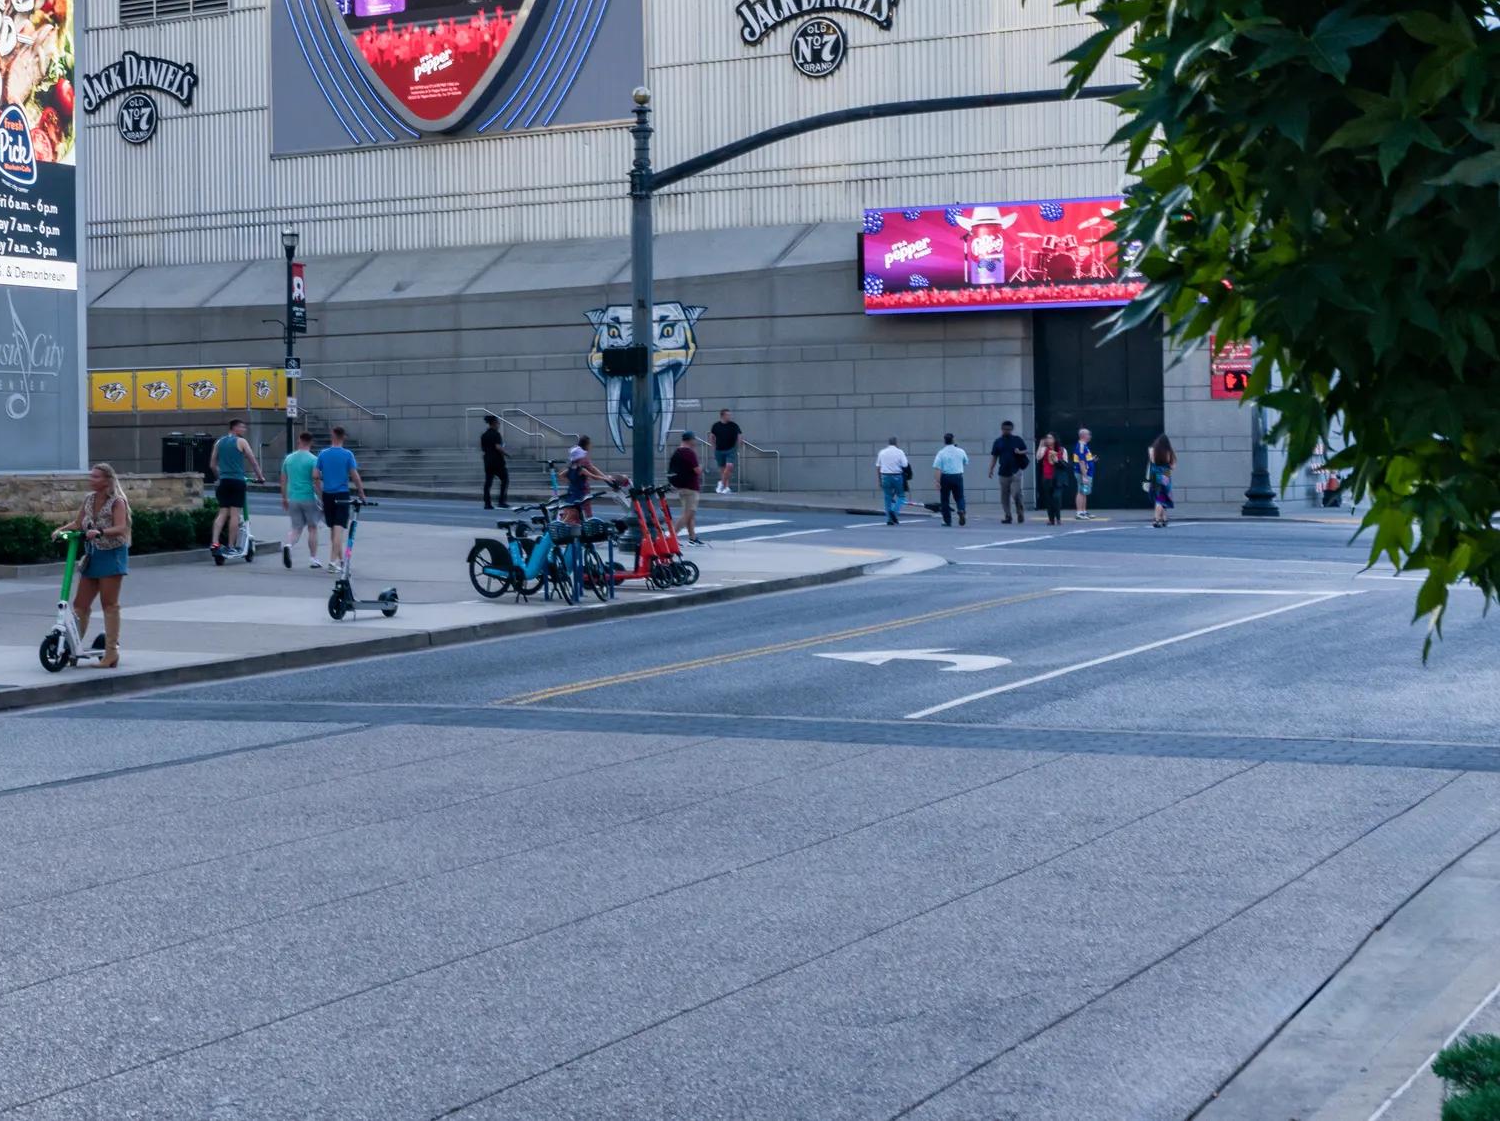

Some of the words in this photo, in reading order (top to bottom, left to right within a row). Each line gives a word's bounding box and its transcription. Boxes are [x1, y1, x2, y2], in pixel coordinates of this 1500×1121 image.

[83, 64, 125, 111] JACK
[123, 54, 194, 100] DANIEL'S
[3, 117, 24, 132] fresh
[6, 265, 12, 277] &
[31, 333, 65, 373] City
